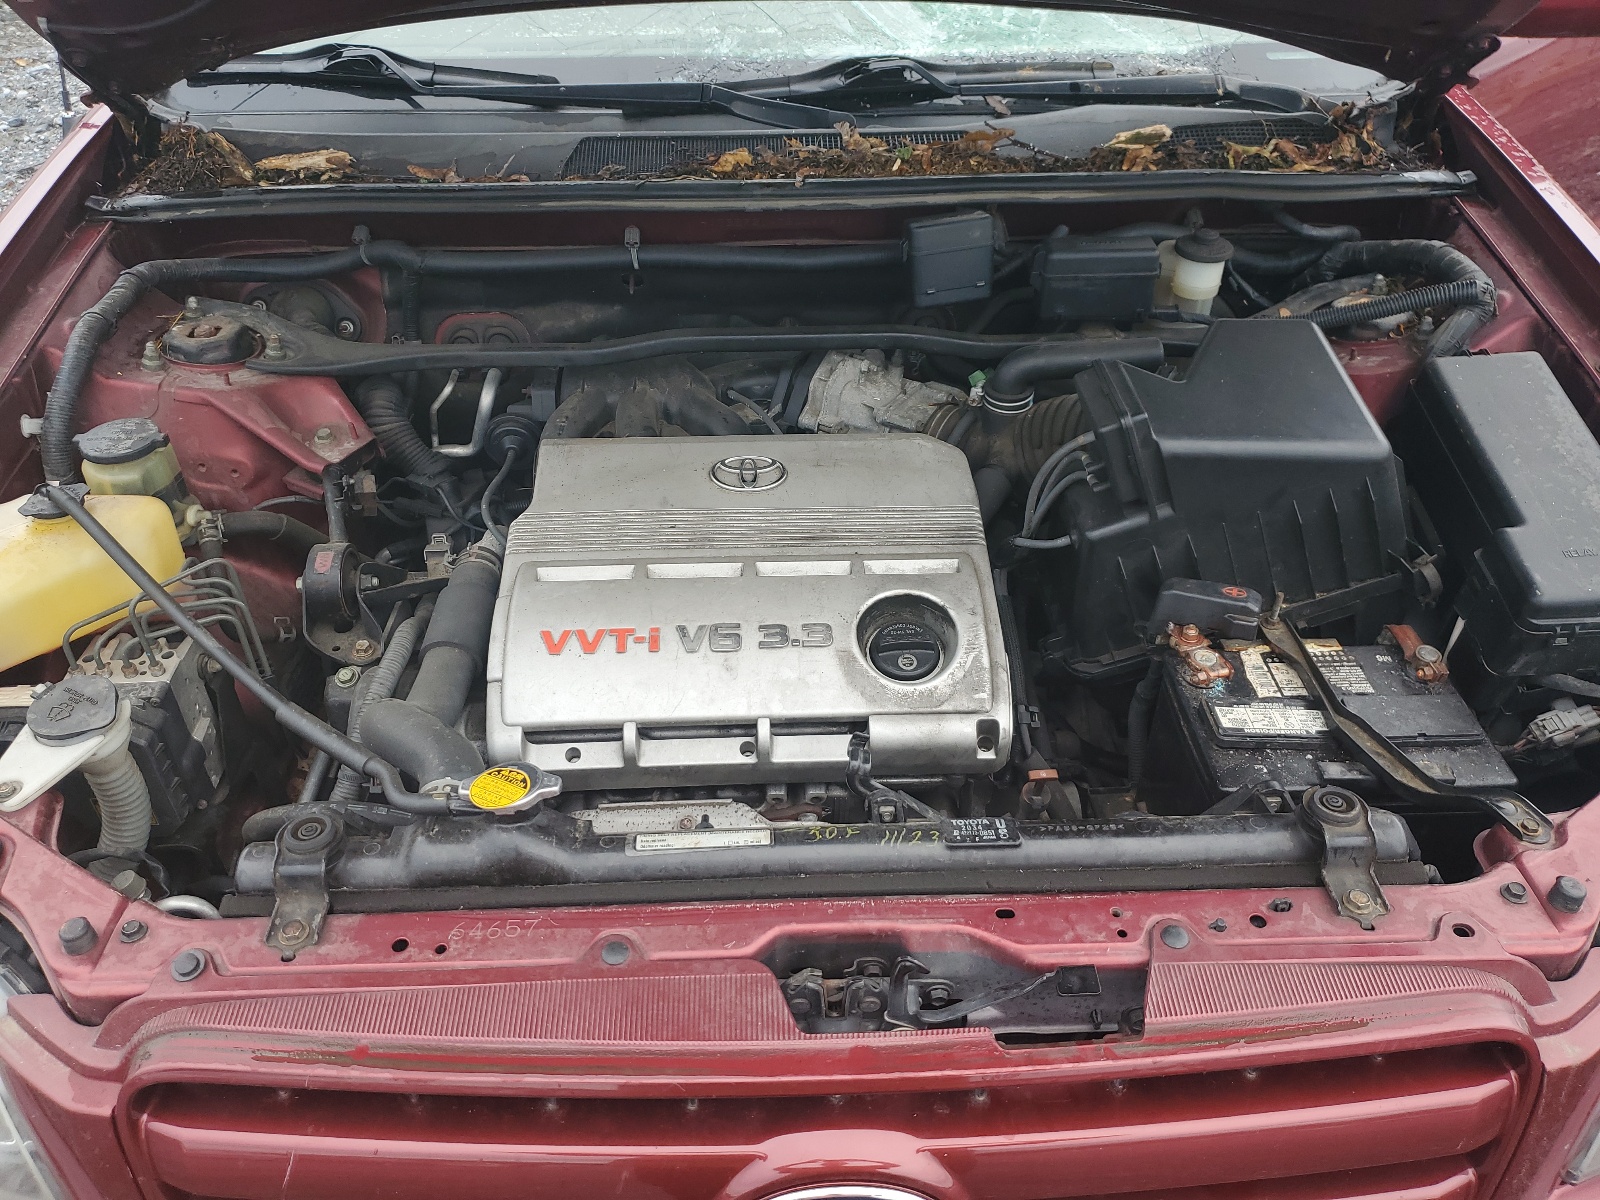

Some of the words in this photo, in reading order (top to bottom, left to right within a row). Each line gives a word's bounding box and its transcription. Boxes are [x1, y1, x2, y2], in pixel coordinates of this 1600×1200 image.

[540, 626, 661, 655] VVT-i
[675, 622, 743, 653] V6
[758, 622, 834, 649] 3.3
[490, 771, 526, 788] CAUTION
[950, 818, 990, 826] TOYOTA
[448, 919, 539, 940] 64657
